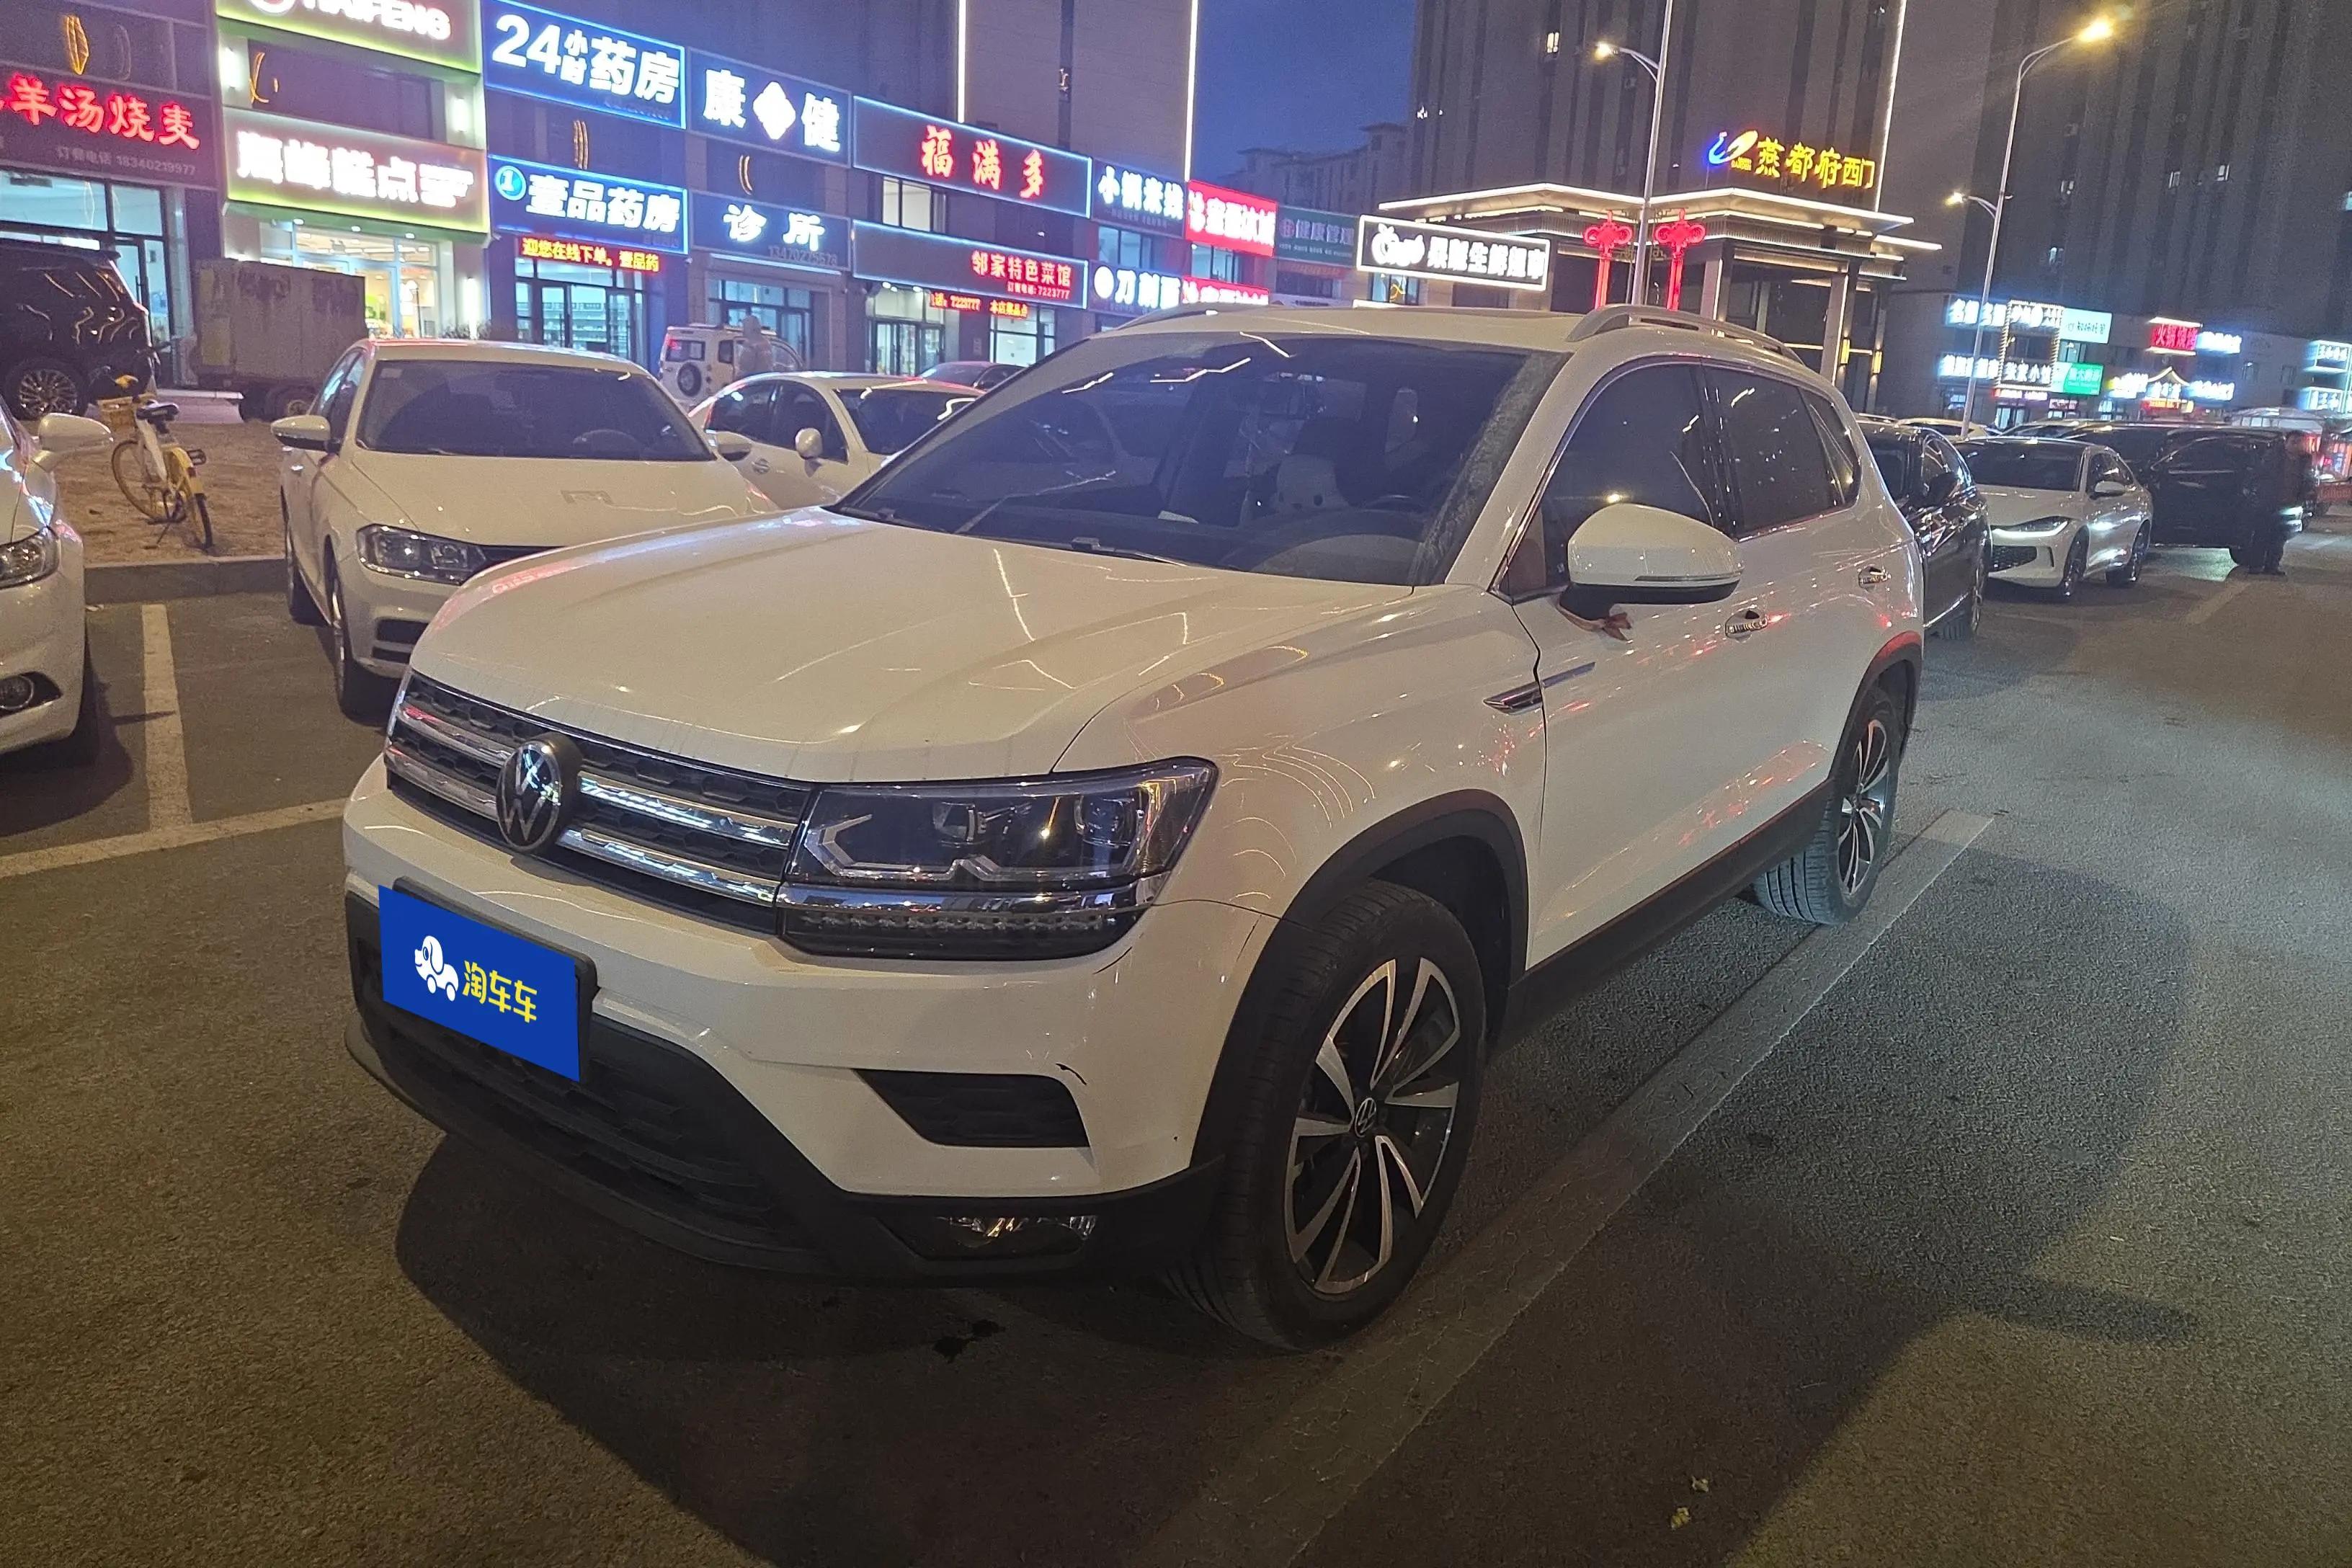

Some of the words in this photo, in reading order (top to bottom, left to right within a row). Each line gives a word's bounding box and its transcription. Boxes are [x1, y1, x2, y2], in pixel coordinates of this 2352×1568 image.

[491, 14, 680, 104] 24小时药房
[0, 73, 200, 150] 羊汤烧麦
[921, 124, 1044, 199] 福满多
[1755, 136, 1876, 189] 燕都府西门
[525, 174, 681, 233] 壹品药房
[723, 203, 826, 252] 诊所
[971, 250, 1072, 288] 邻家特色菜馆
